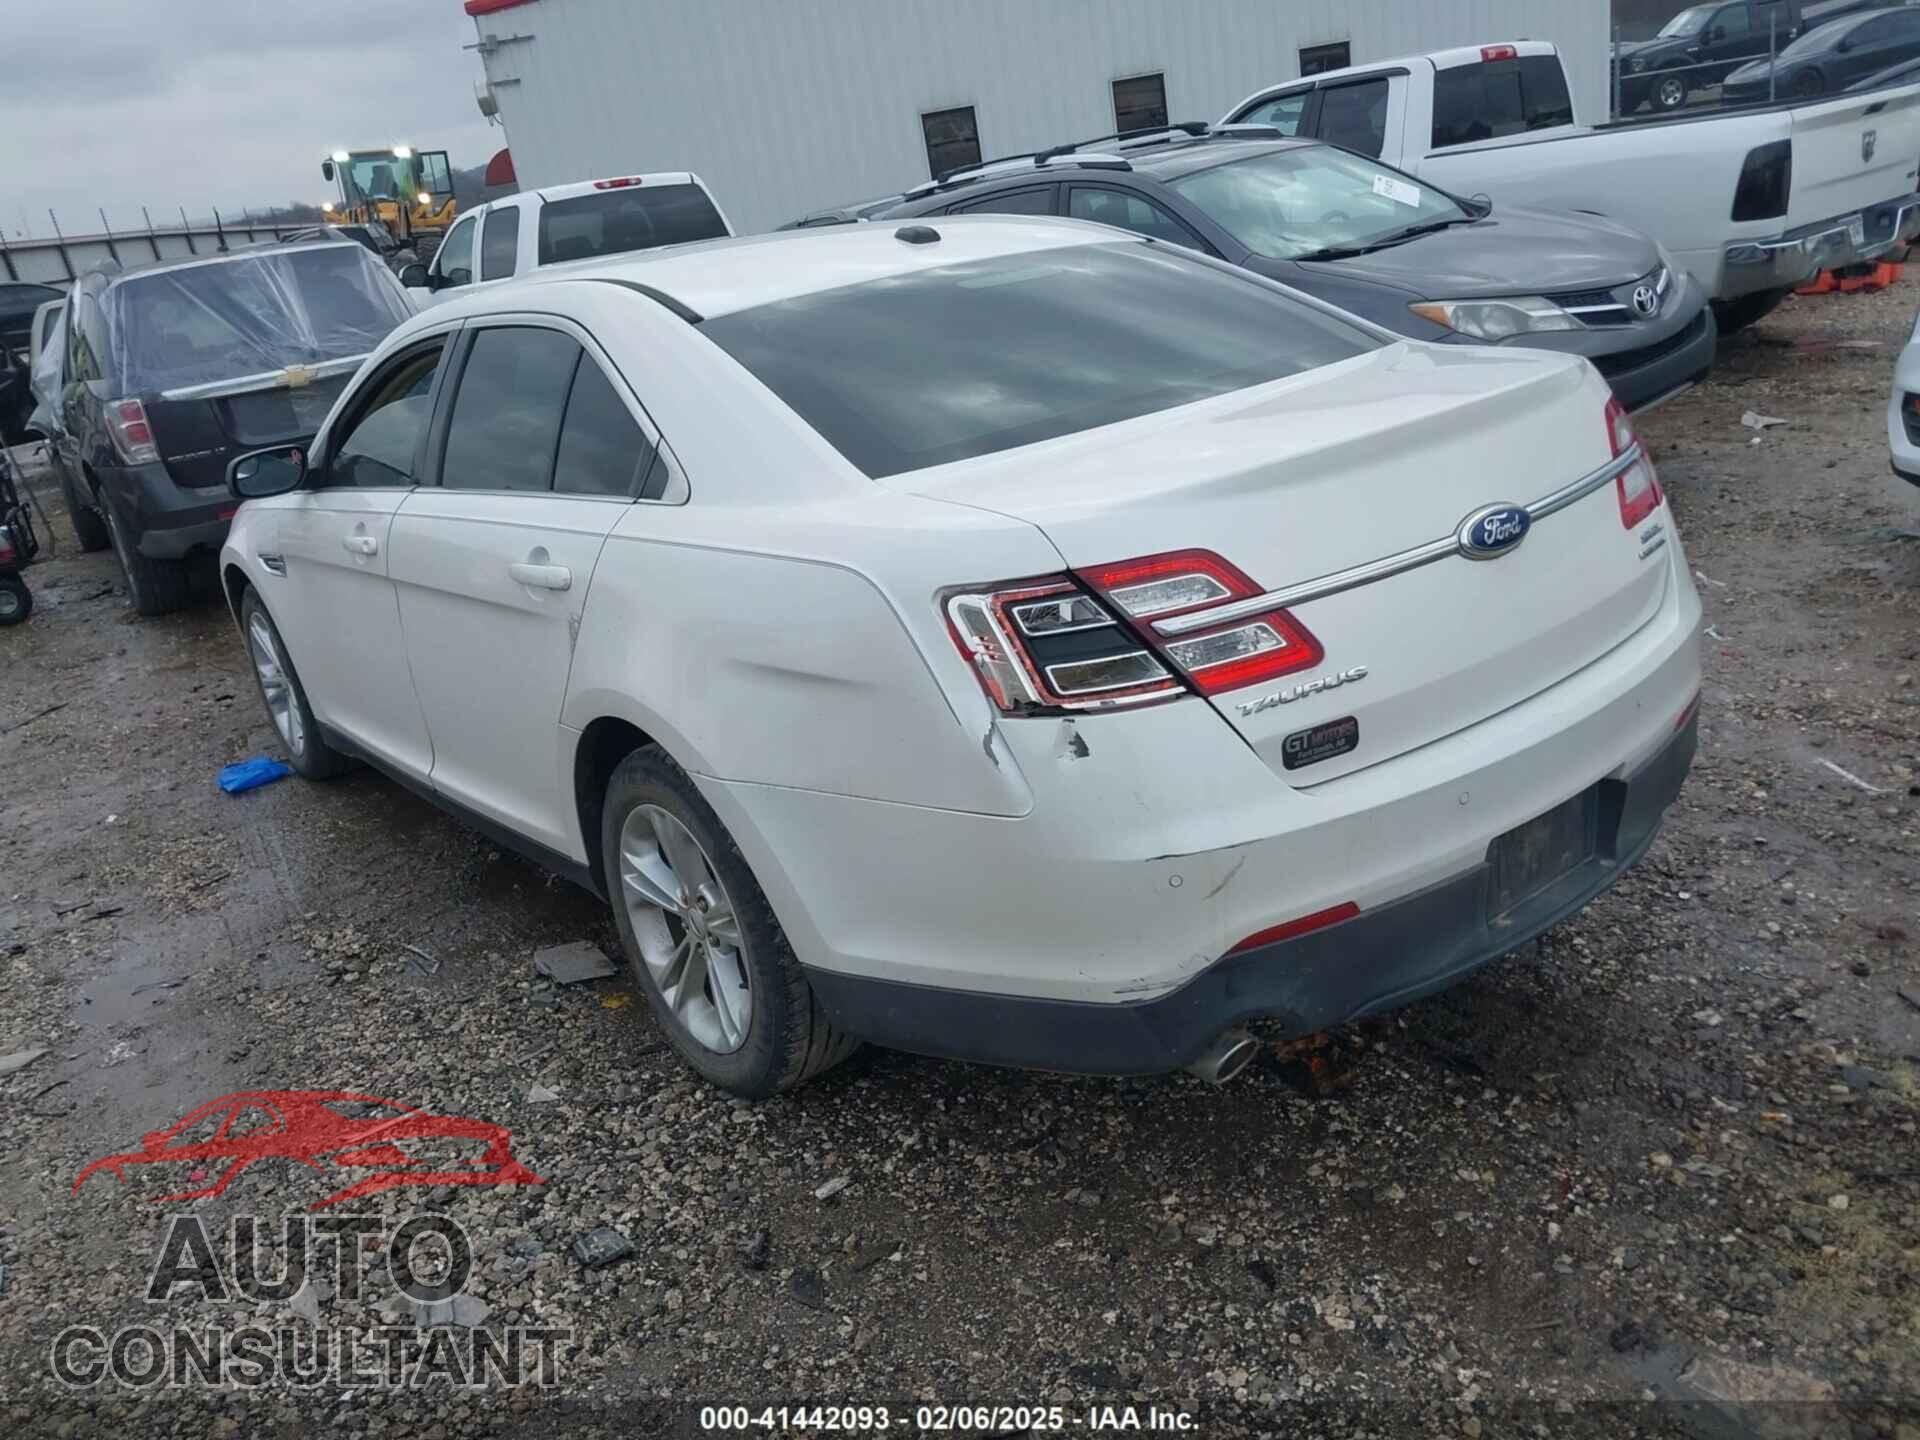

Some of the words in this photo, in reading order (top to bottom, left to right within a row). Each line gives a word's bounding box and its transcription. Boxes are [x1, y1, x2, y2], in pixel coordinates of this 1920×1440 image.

[1484, 511, 1521, 545] Ford
[1235, 665, 1369, 717] TAURUS
[1285, 729, 1312, 753] GT
